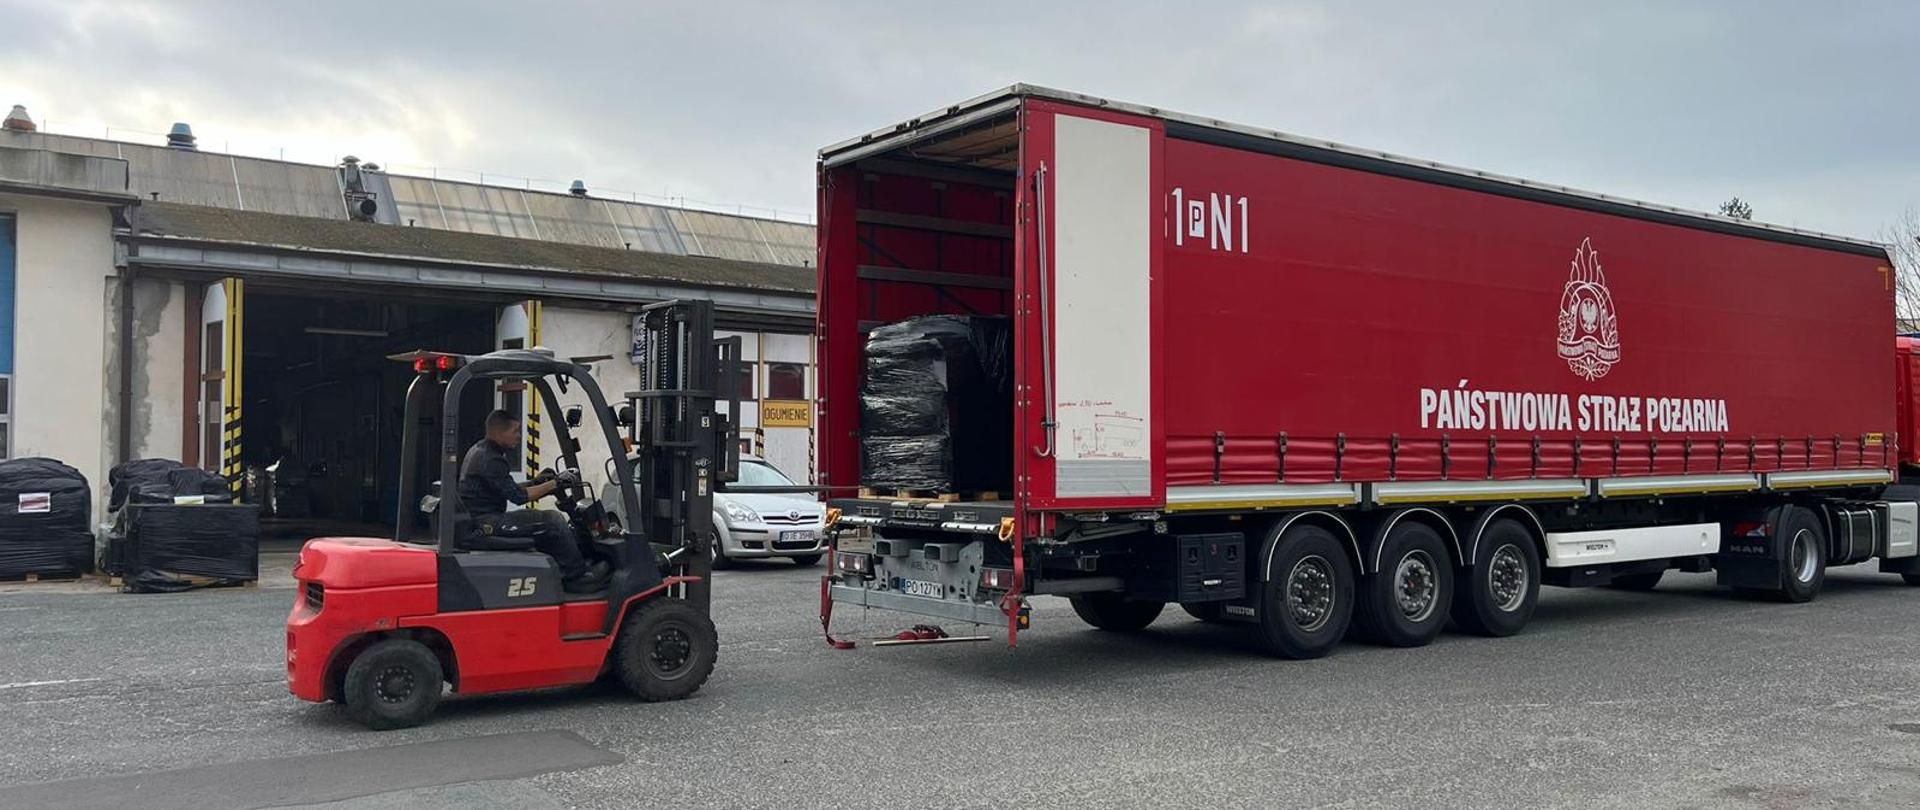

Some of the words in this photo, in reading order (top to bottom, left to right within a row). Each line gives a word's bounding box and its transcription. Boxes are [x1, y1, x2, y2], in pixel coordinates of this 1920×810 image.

[764, 408, 808, 421] OGUMIENIE
[1420, 379, 1572, 431] PAŃSTWOWA
[1578, 394, 1641, 432] STRAŻ
[1646, 397, 1728, 433] POŻARNA
